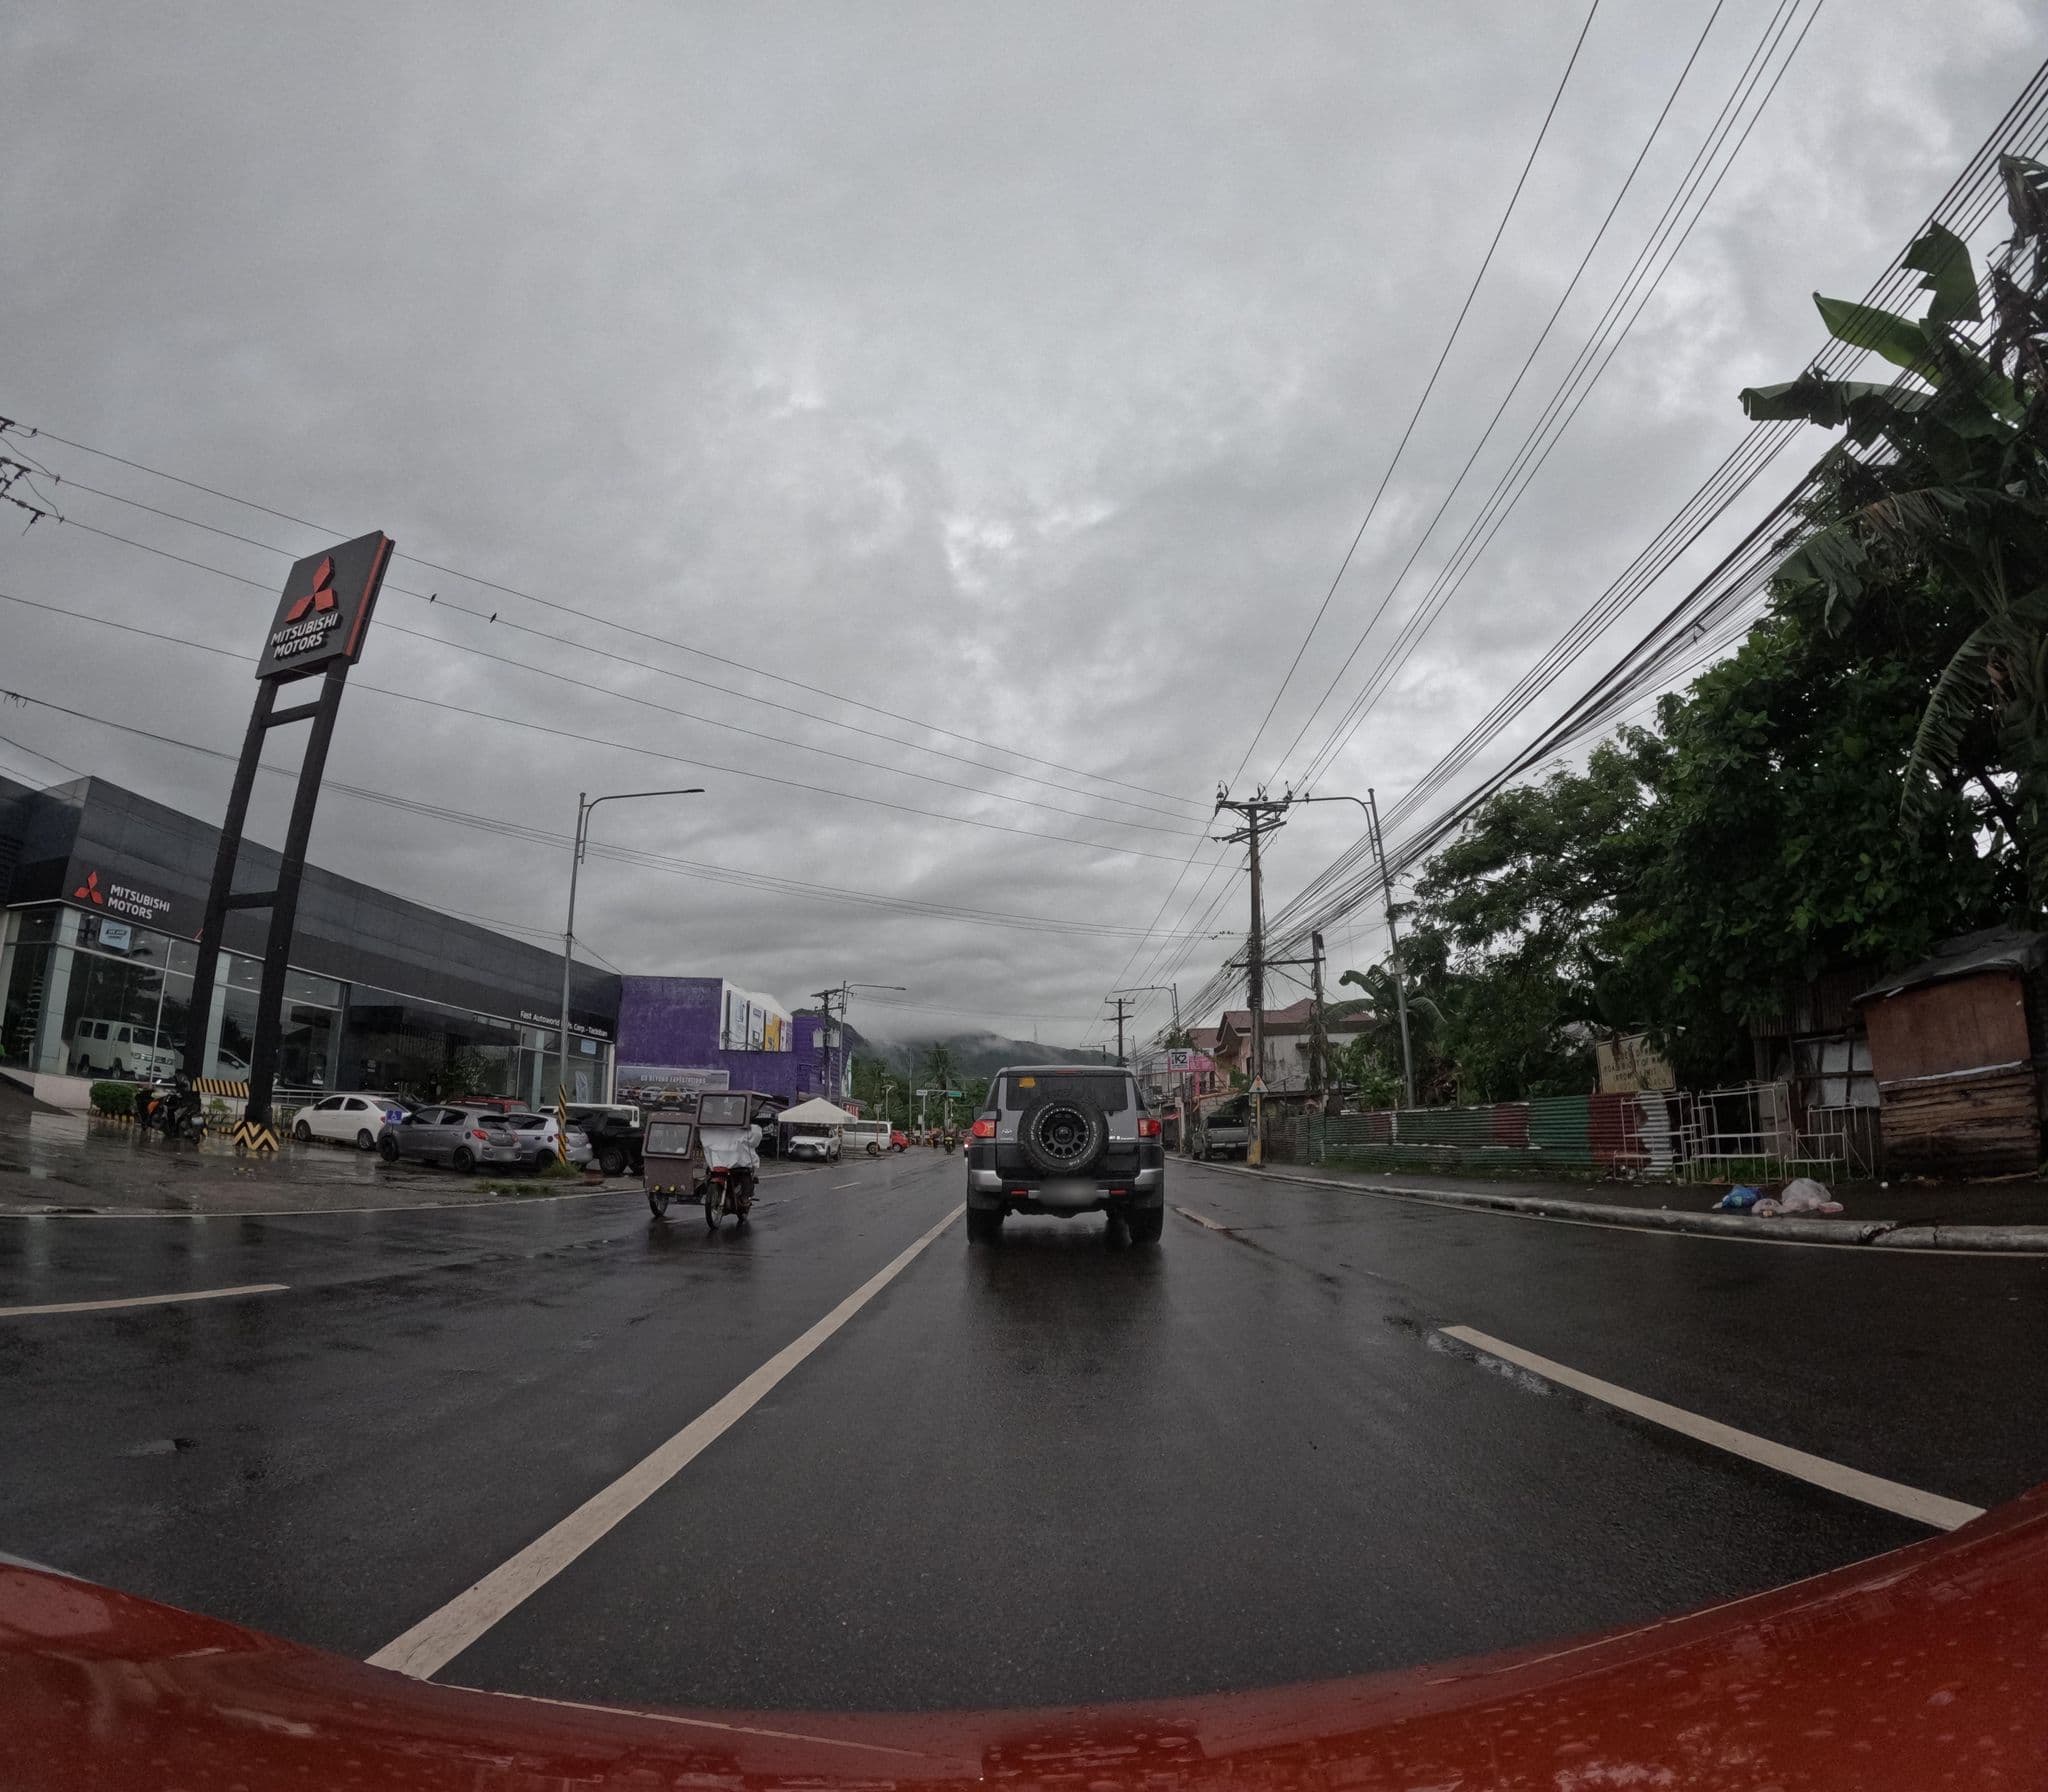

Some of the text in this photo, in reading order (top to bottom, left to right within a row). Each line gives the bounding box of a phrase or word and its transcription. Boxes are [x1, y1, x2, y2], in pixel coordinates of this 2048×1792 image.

[270, 612, 338, 646] MITSUBISHI
[273, 631, 324, 658] MOTORS
[108, 897, 153, 919] MOTORS
[111, 884, 170, 912] MITSUBISHI
[520, 1010, 532, 1021] Fast
[533, 1014, 560, 1026] Autoworld
